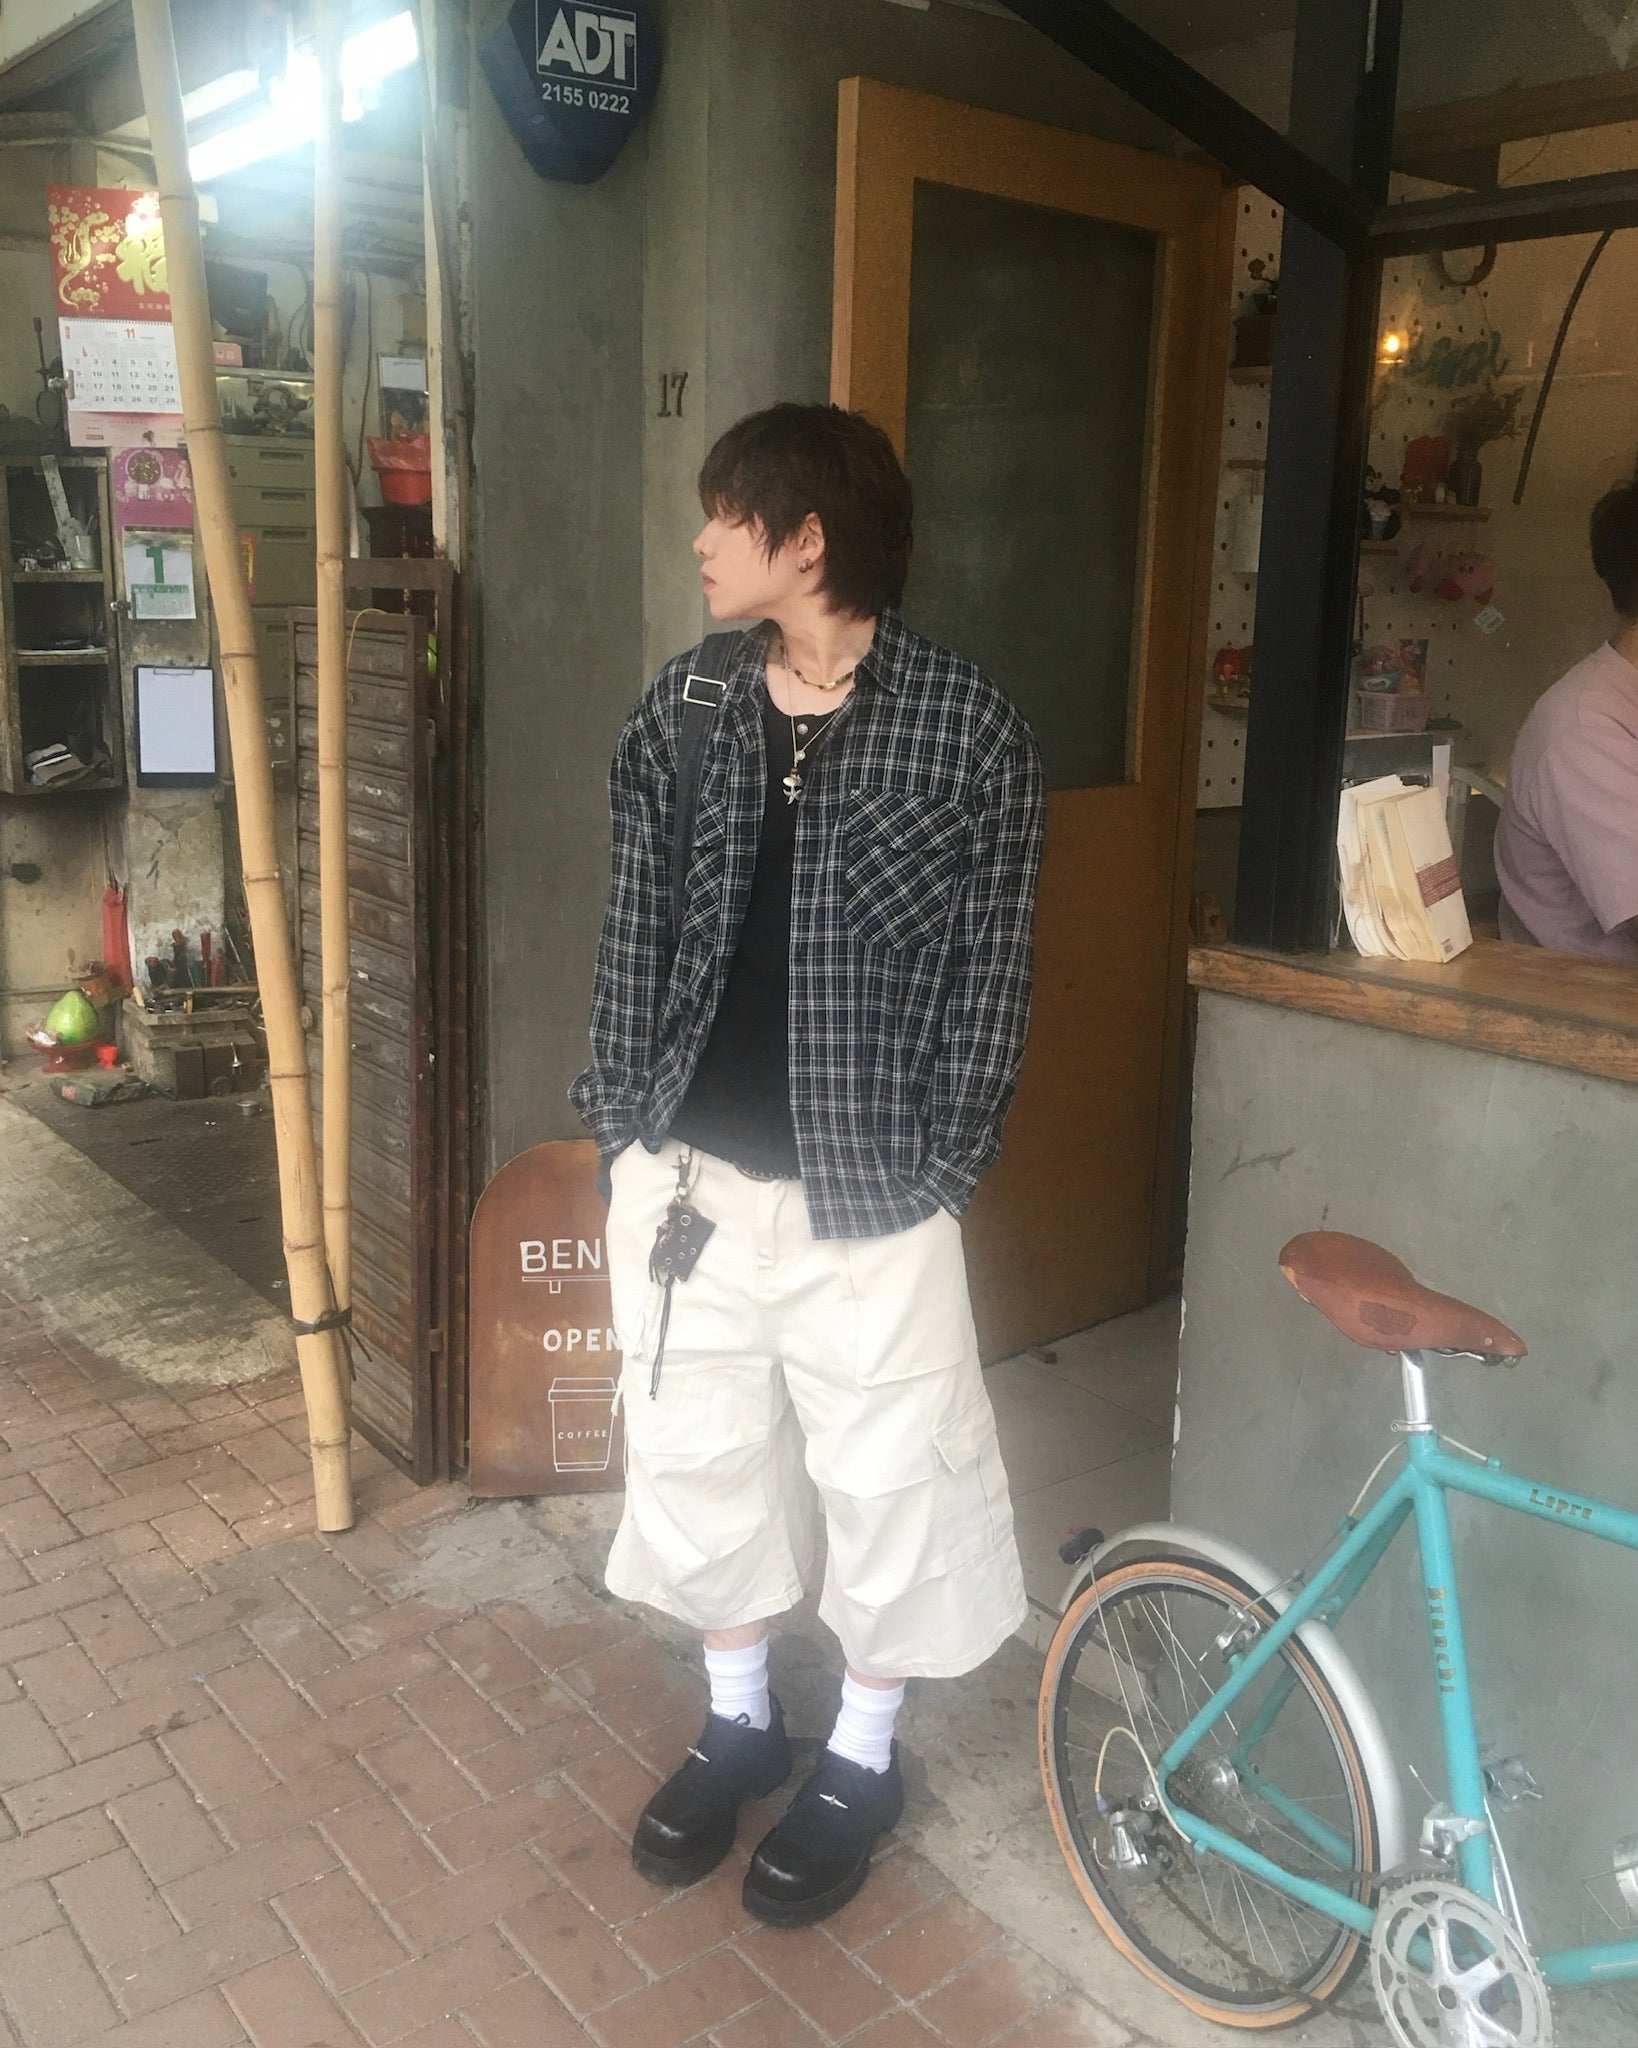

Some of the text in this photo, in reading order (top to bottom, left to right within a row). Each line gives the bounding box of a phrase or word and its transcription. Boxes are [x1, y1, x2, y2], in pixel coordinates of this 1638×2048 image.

[538, 7, 636, 80] ADT
[542, 83, 630, 114] 2155 0222
[657, 371, 688, 418] 17
[146, 546, 164, 584] 1
[543, 1328, 622, 1351] OPEN
[557, 1429, 608, 1440] COFFEE
